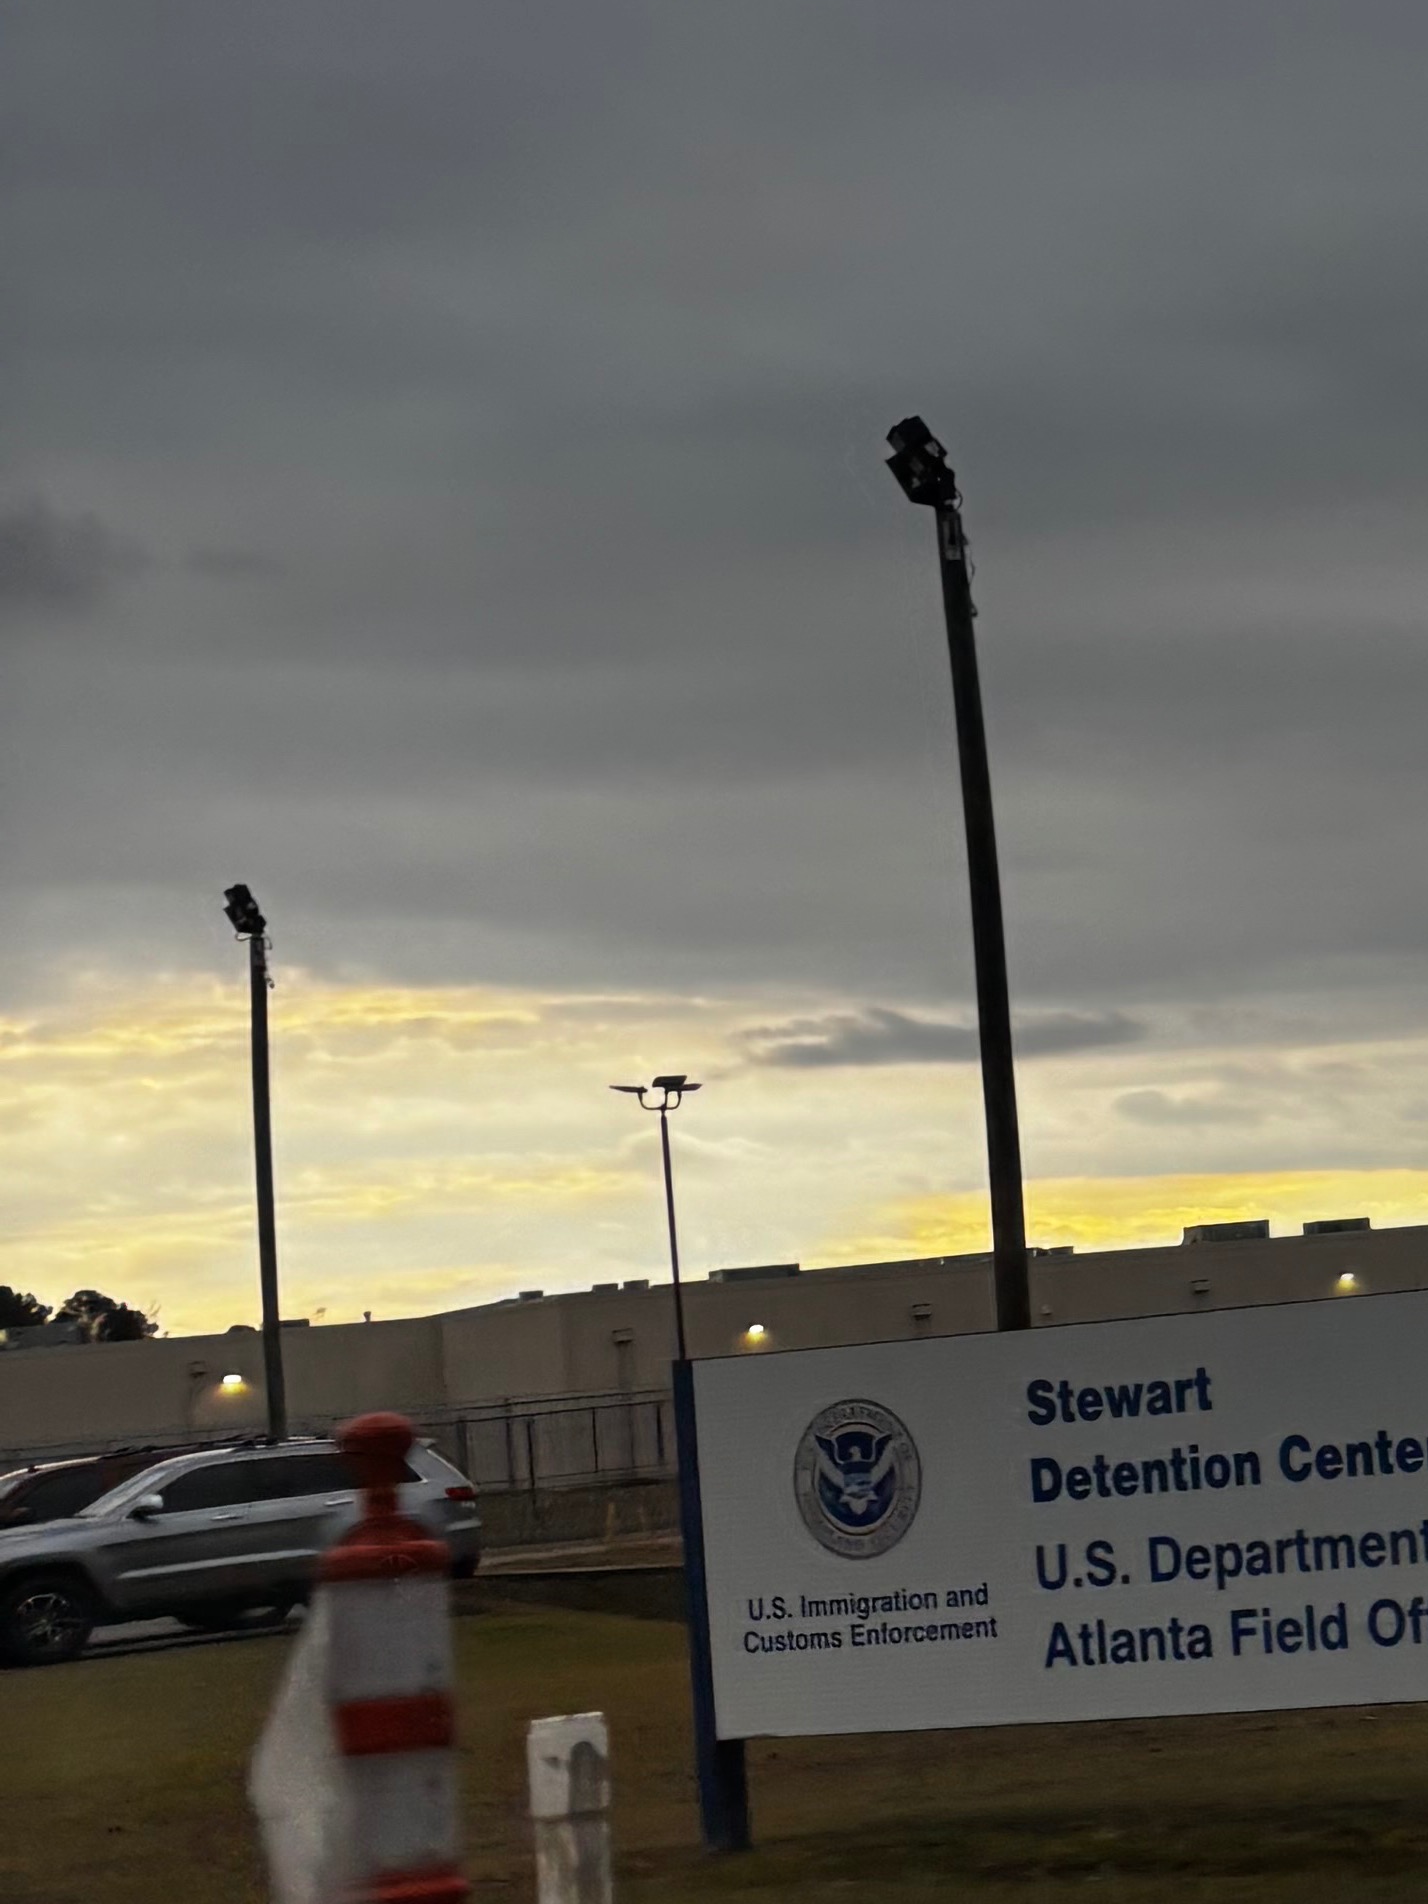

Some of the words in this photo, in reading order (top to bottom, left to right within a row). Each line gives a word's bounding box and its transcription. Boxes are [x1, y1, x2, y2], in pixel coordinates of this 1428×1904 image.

[1027, 1367, 1212, 1425] Stewart
[1031, 1445, 1261, 1502] Detention
[1036, 1540, 1130, 1590] U.S.
[749, 1597, 793, 1621] U.S.
[801, 1588, 937, 1620] Immigration
[947, 1583, 988, 1607] and
[744, 1631, 842, 1653] Customs
[850, 1617, 997, 1646] Enforcement
[1045, 1618, 1213, 1668] Atlanta
[1231, 1602, 1348, 1656] Field
